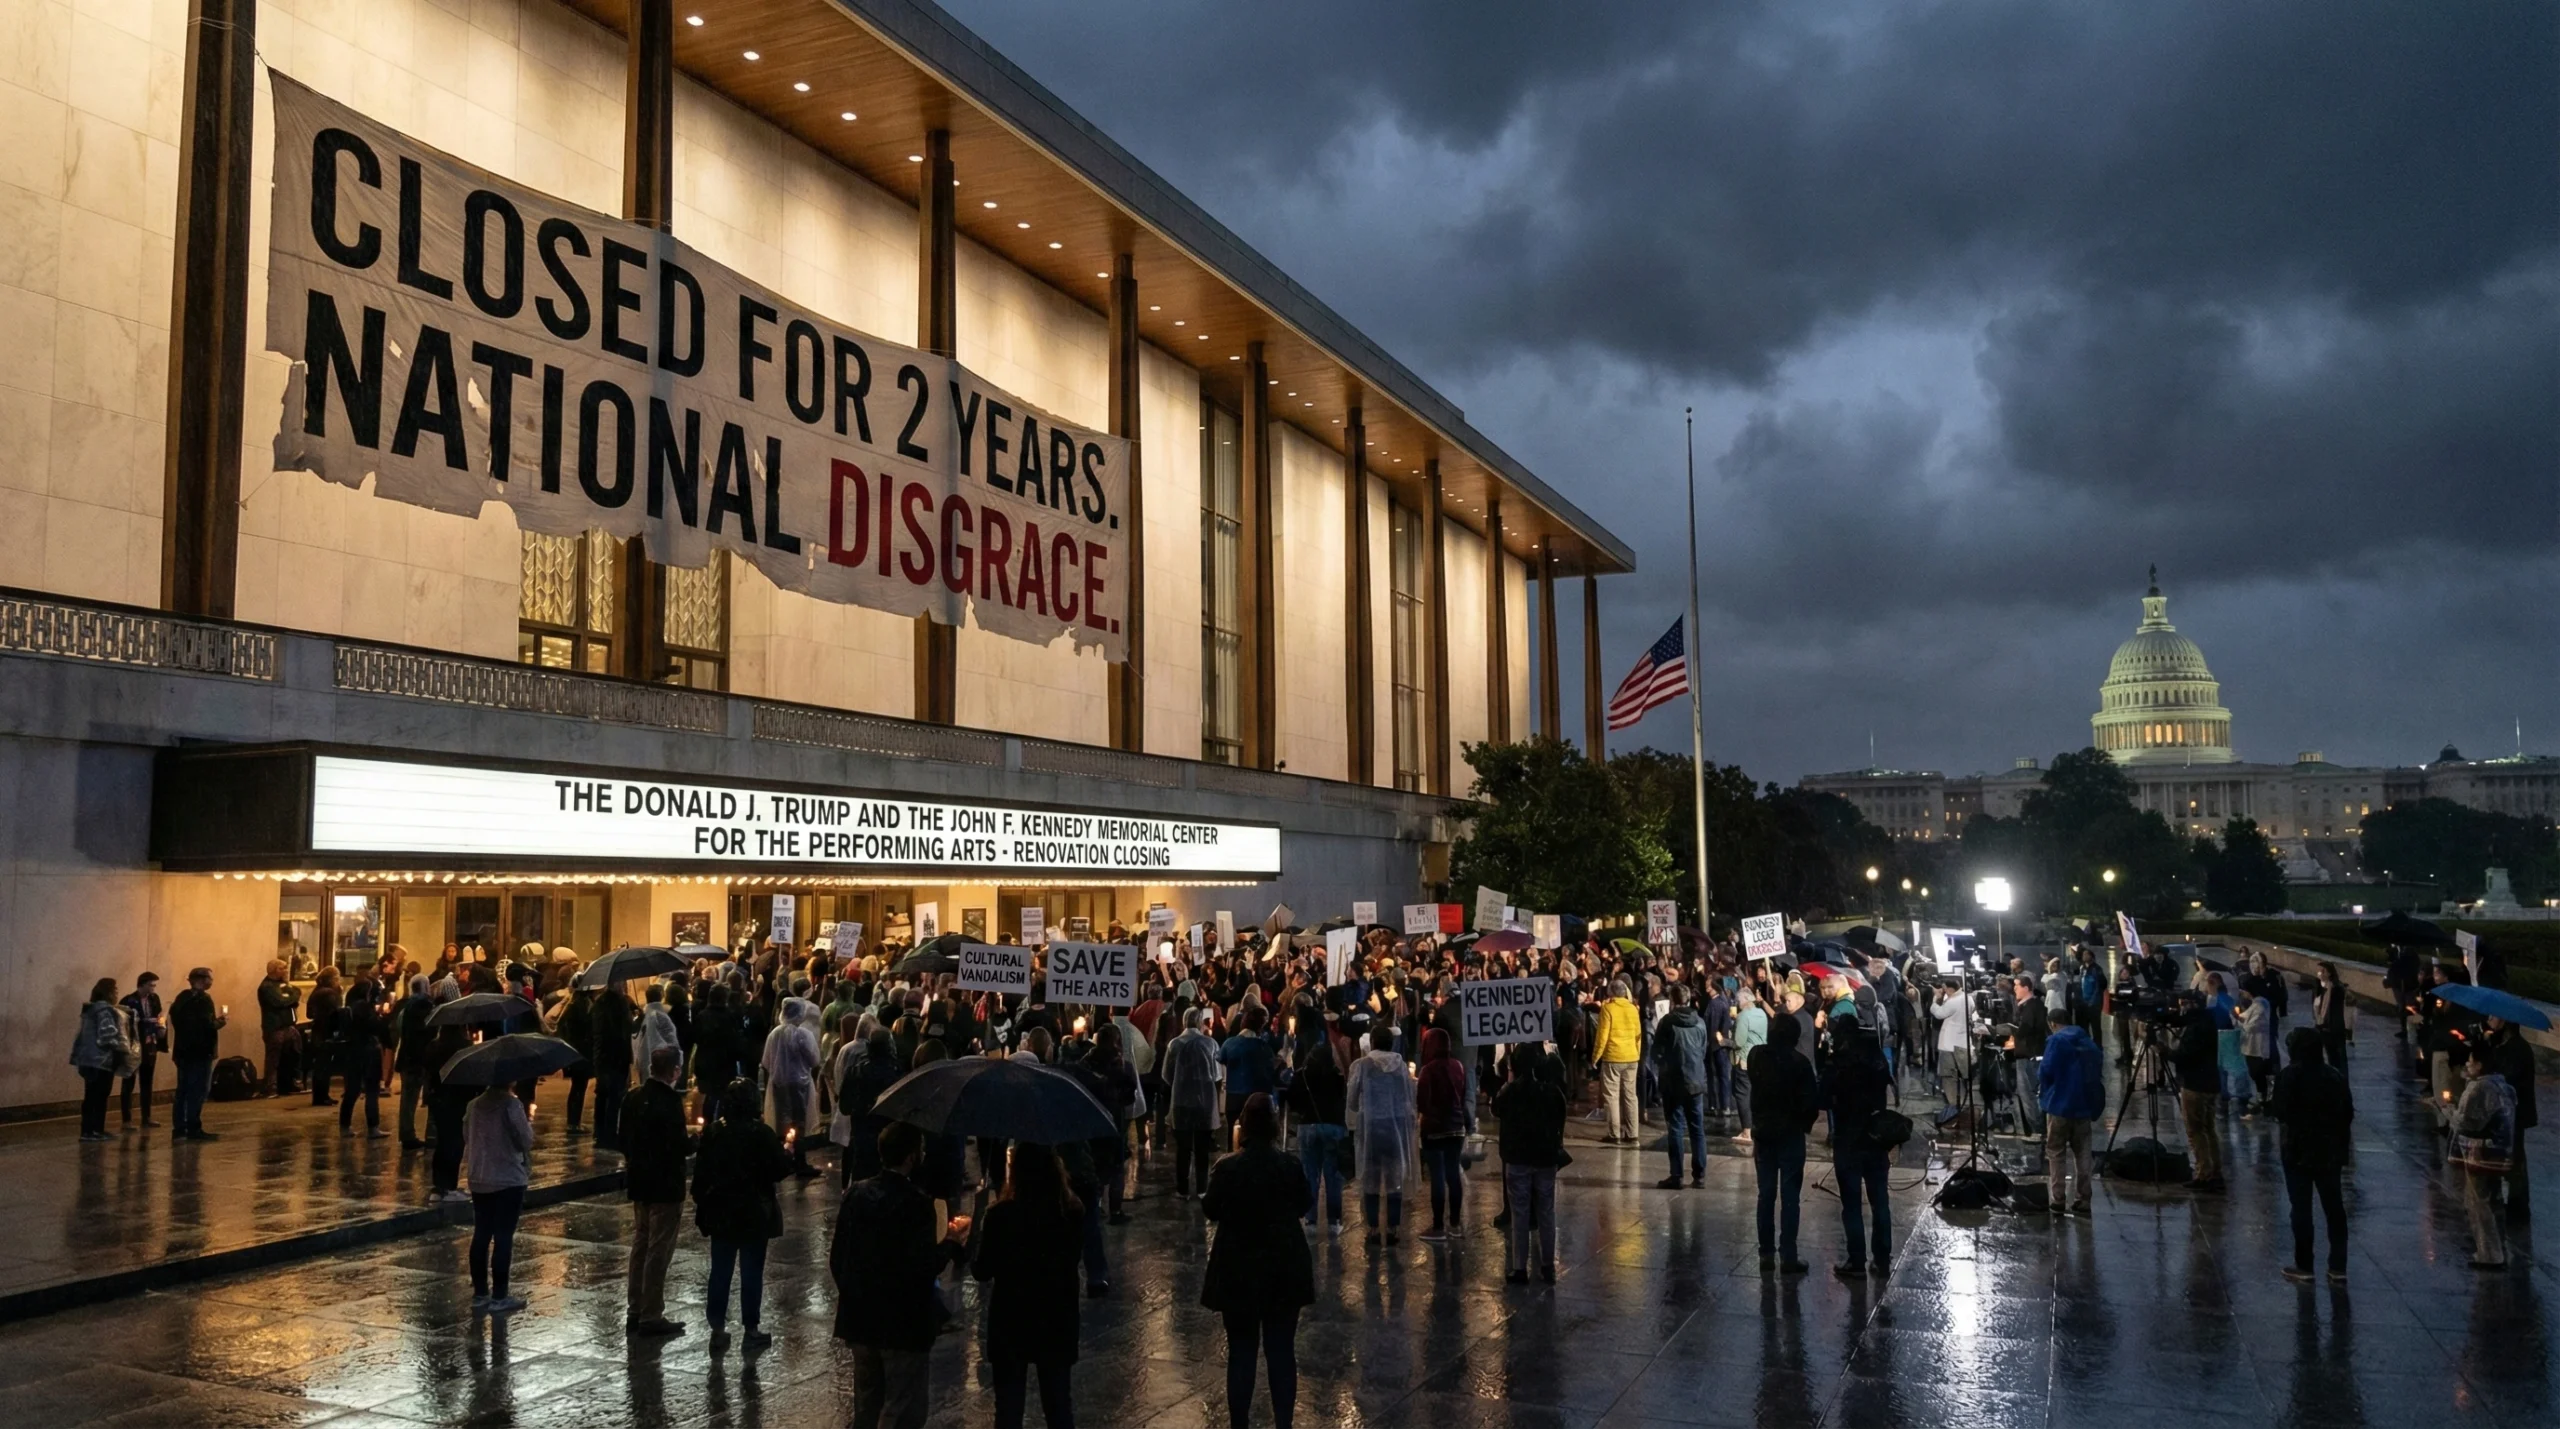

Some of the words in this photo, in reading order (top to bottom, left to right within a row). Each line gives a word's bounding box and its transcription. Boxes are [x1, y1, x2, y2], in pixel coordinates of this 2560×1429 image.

[310, 127, 706, 378] CLOSED
[739, 294, 873, 444] FOR
[897, 364, 929, 463] 2
[949, 380, 1119, 529] YEARS.
[304, 289, 801, 556] NATIONAL
[828, 457, 1120, 634] DISGRACE.
[555, 780, 613, 813] THE
[625, 785, 737, 820] DONALD
[745, 794, 761, 822] J.
[771, 796, 850, 826] TRUMP
[857, 803, 901, 829] AND
[908, 806, 944, 831] THE
[950, 809, 997, 834] JOHN
[1003, 813, 1015, 835] F.
[1021, 814, 1092, 840] KENNEDY
[1098, 819, 1169, 843] MEMORIAL
[1172, 825, 1218, 845] CENTER
[695, 827, 746, 856] FOR
[755, 829, 801, 857] THE
[809, 832, 944, 861] PERFORMING
[950, 838, 997, 862] ARTS
[1014, 841, 1109, 865] RENOVATION
[1114, 845, 1170, 866] CLOSING
[965, 951, 1025, 968] CULTURAL
[1053, 948, 1126, 977] SAVE
[960, 968, 1026, 985] VANDALISM
[1052, 979, 1084, 997] THE
[1087, 981, 1130, 999] ARTS
[1465, 983, 1547, 1009] KENNEDY
[1466, 1009, 1547, 1038] LEGACY
